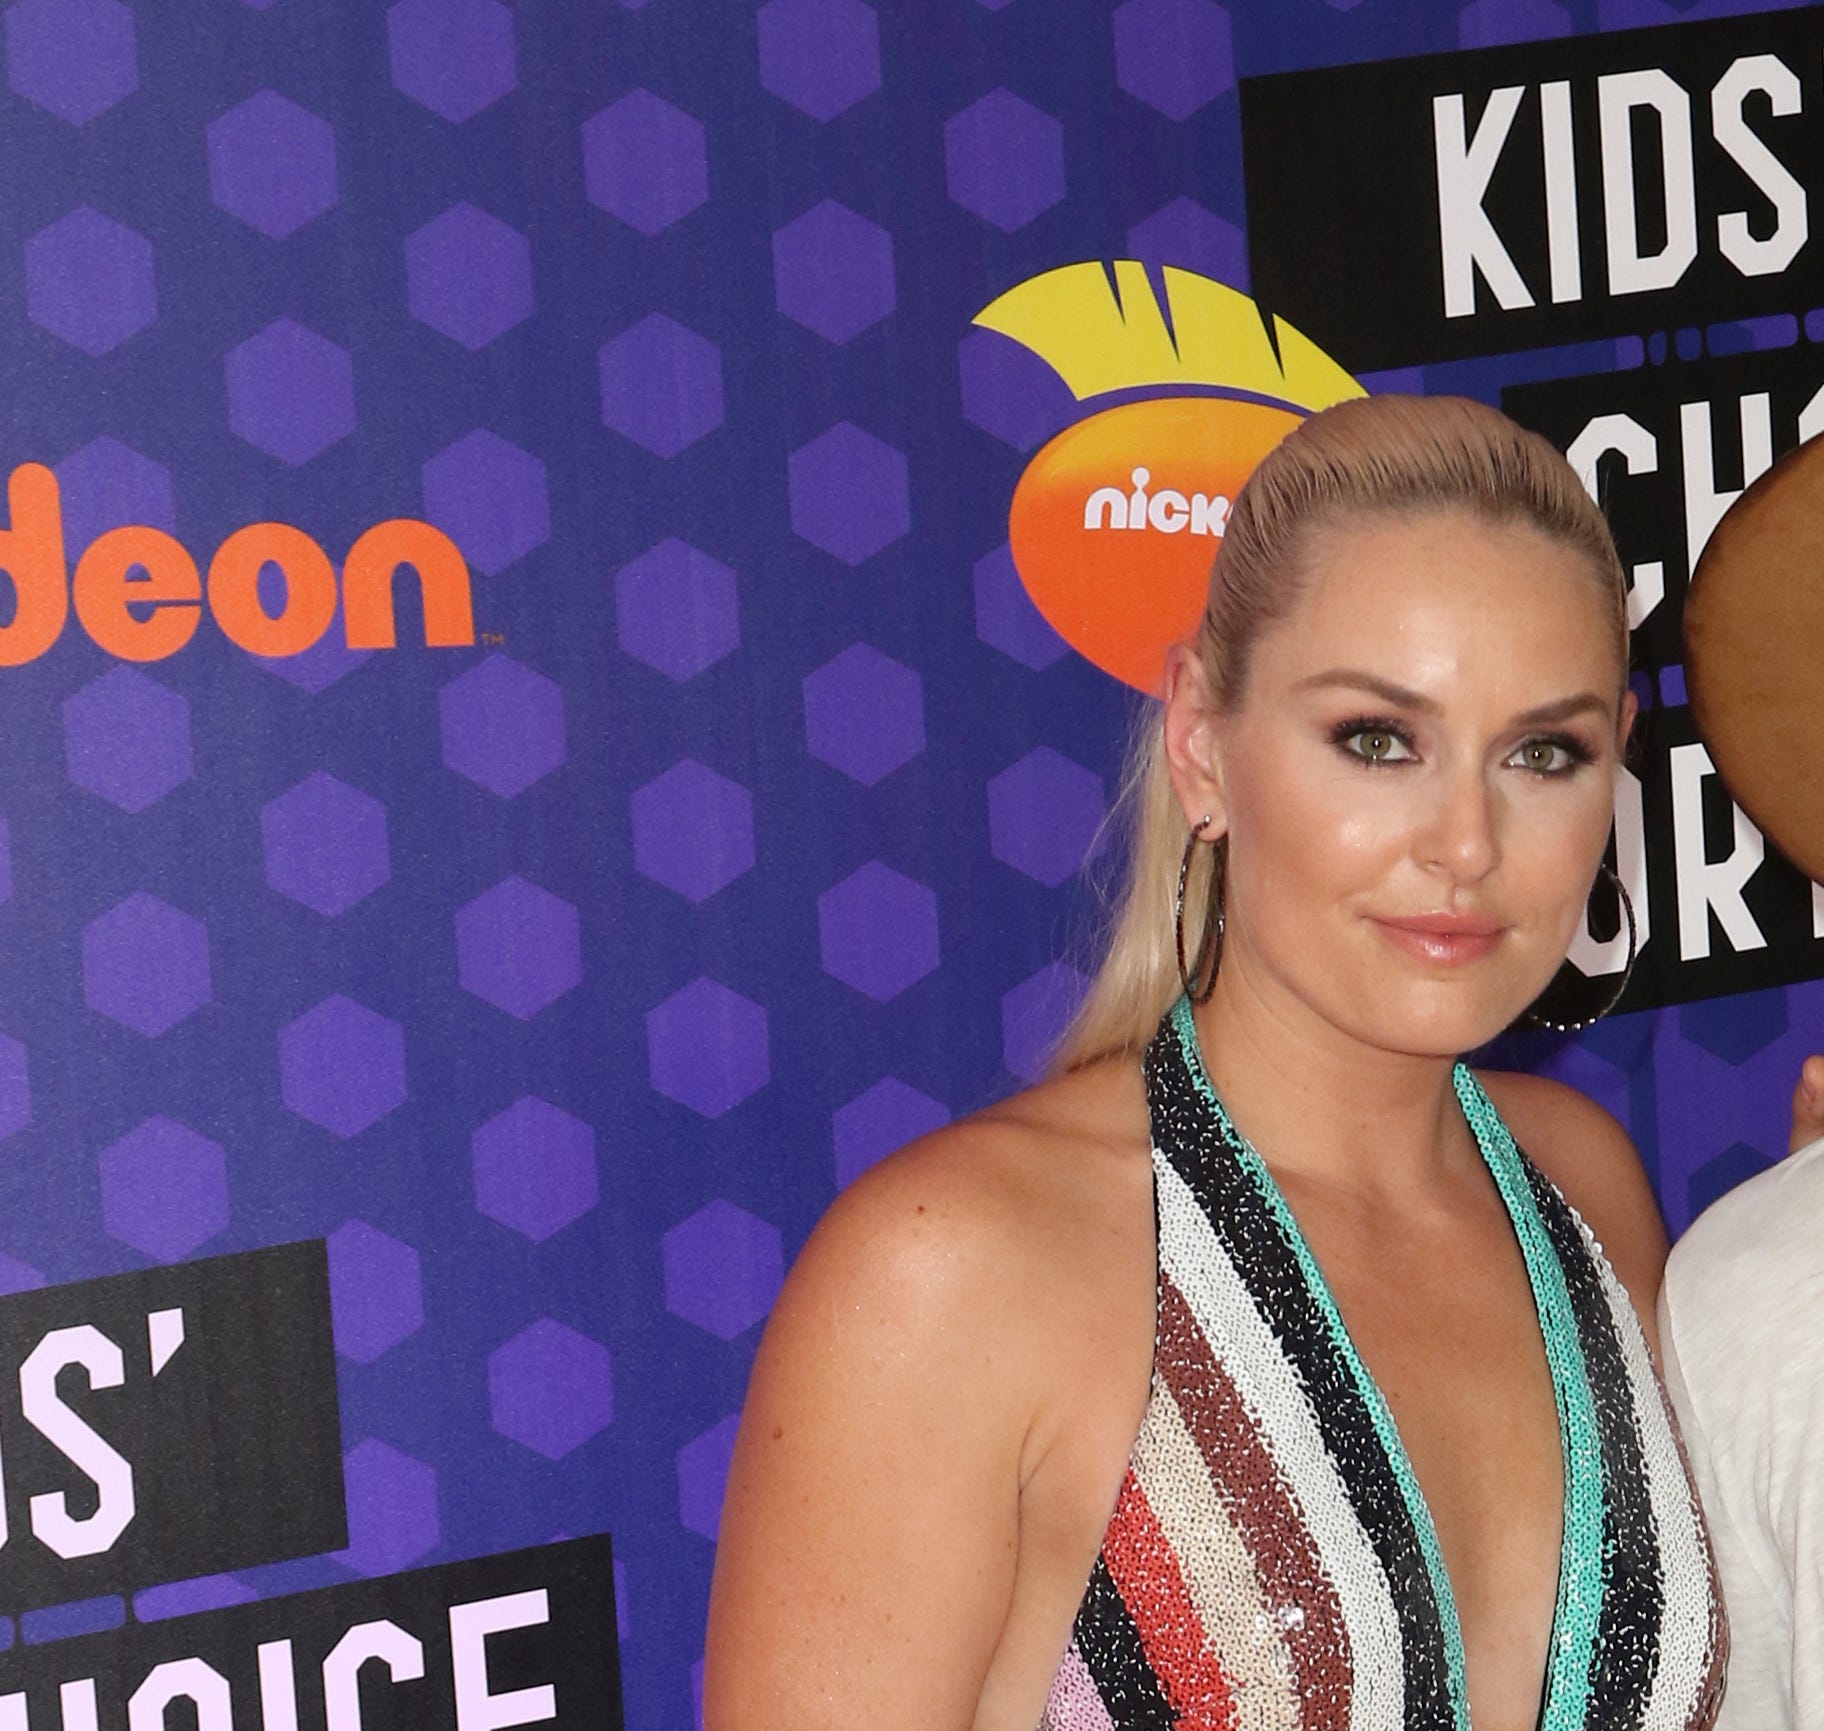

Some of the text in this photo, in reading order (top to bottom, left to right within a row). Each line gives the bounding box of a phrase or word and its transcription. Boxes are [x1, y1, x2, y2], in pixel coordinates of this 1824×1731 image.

[0, 461, 475, 667] deon
[1084, 466, 1234, 538] nick
[0, 1307, 186, 1560] S'
